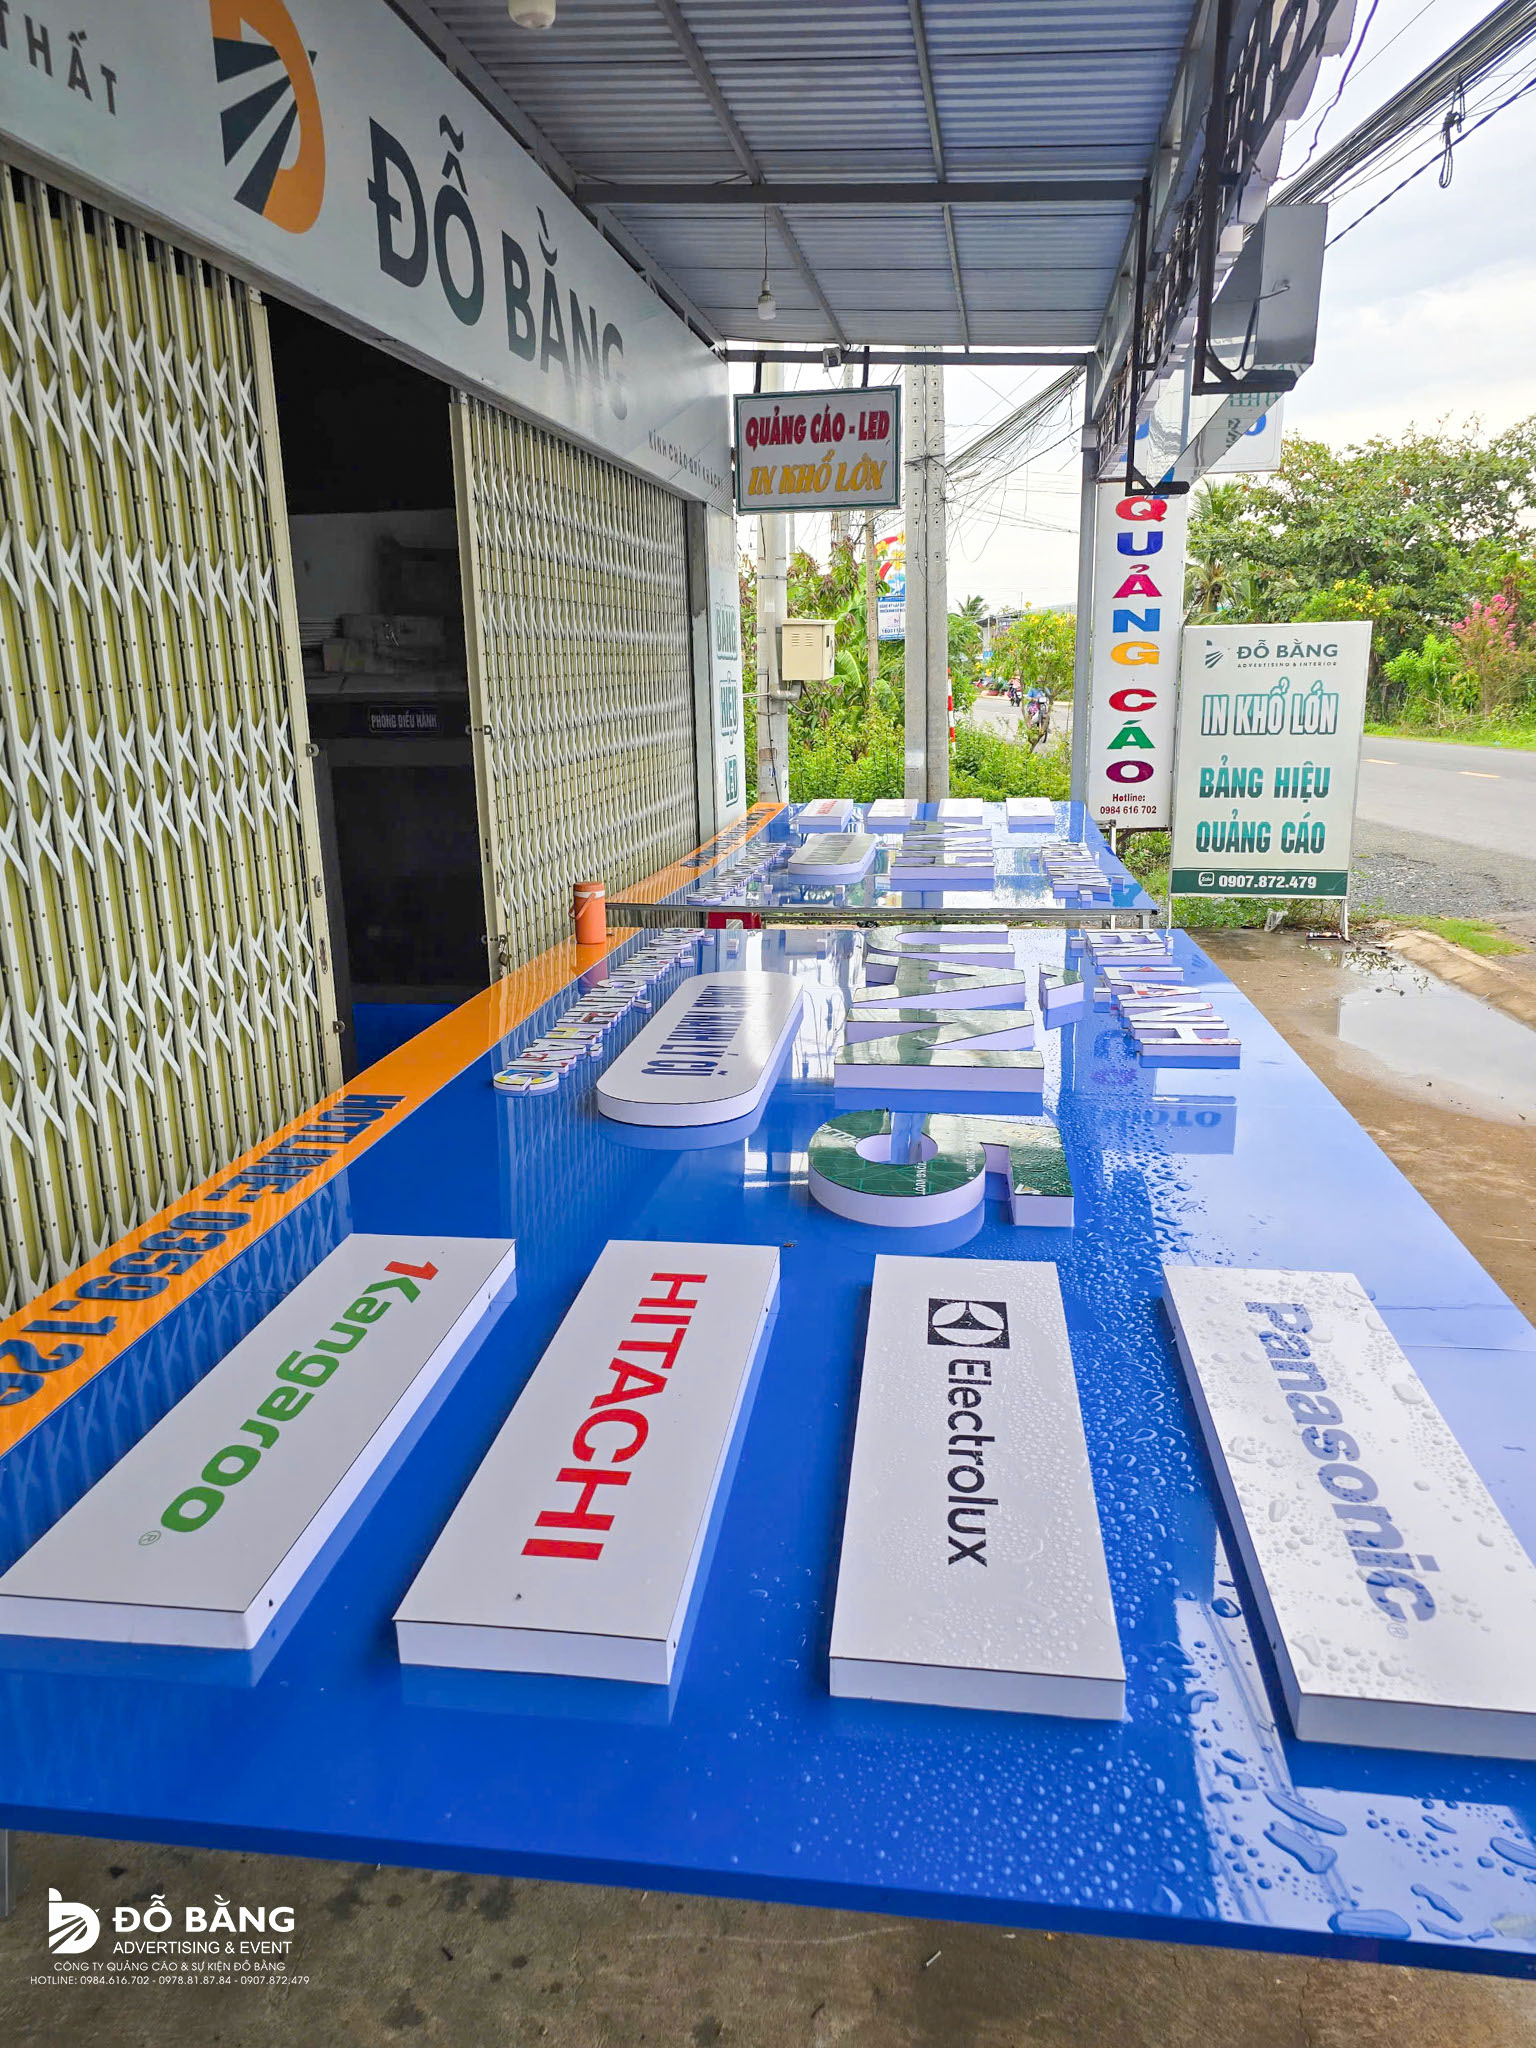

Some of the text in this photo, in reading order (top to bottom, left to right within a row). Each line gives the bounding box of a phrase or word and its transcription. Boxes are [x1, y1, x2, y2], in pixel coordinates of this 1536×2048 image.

[0, 0, 116, 116] THẤT
[367, 113, 628, 421] ĐỖ BẰNG
[649, 429, 667, 456] KÍNH
[745, 405, 807, 452] QUẢNG
[810, 403, 846, 444] CÁO
[858, 410, 890, 441] LED
[748, 465, 778, 496] IN
[779, 449, 836, 495] KHỔ
[1110, 496, 1168, 666] QUẢNG
[1237, 638, 1338, 659] ĐỖ BẰNG
[1201, 676, 1339, 736] IN KHỔ LỚN
[1105, 688, 1158, 783] CÁO
[724, 754, 738, 807] LED
[1112, 793, 1146, 802] Hotline:
[1199, 755, 1331, 803] BẢNG HIỆU
[1100, 805, 1157, 815] 0984 616 702
[1195, 808, 1326, 854] QUẢNG CÁO
[1218, 875, 1317, 889] 0907.872.479
[666, 1010, 747, 1041] THANH
[641, 1060, 729, 1076] CŨ
[203, 1093, 407, 1203] HOTLINE:
[808, 1108, 1074, 1210] 5
[160, 1261, 439, 1533] Kangaroo
[521, 1272, 708, 1561] HITACHI
[946, 1358, 998, 1567] Electrolux
[1244, 1301, 1441, 1622] Panasonic
